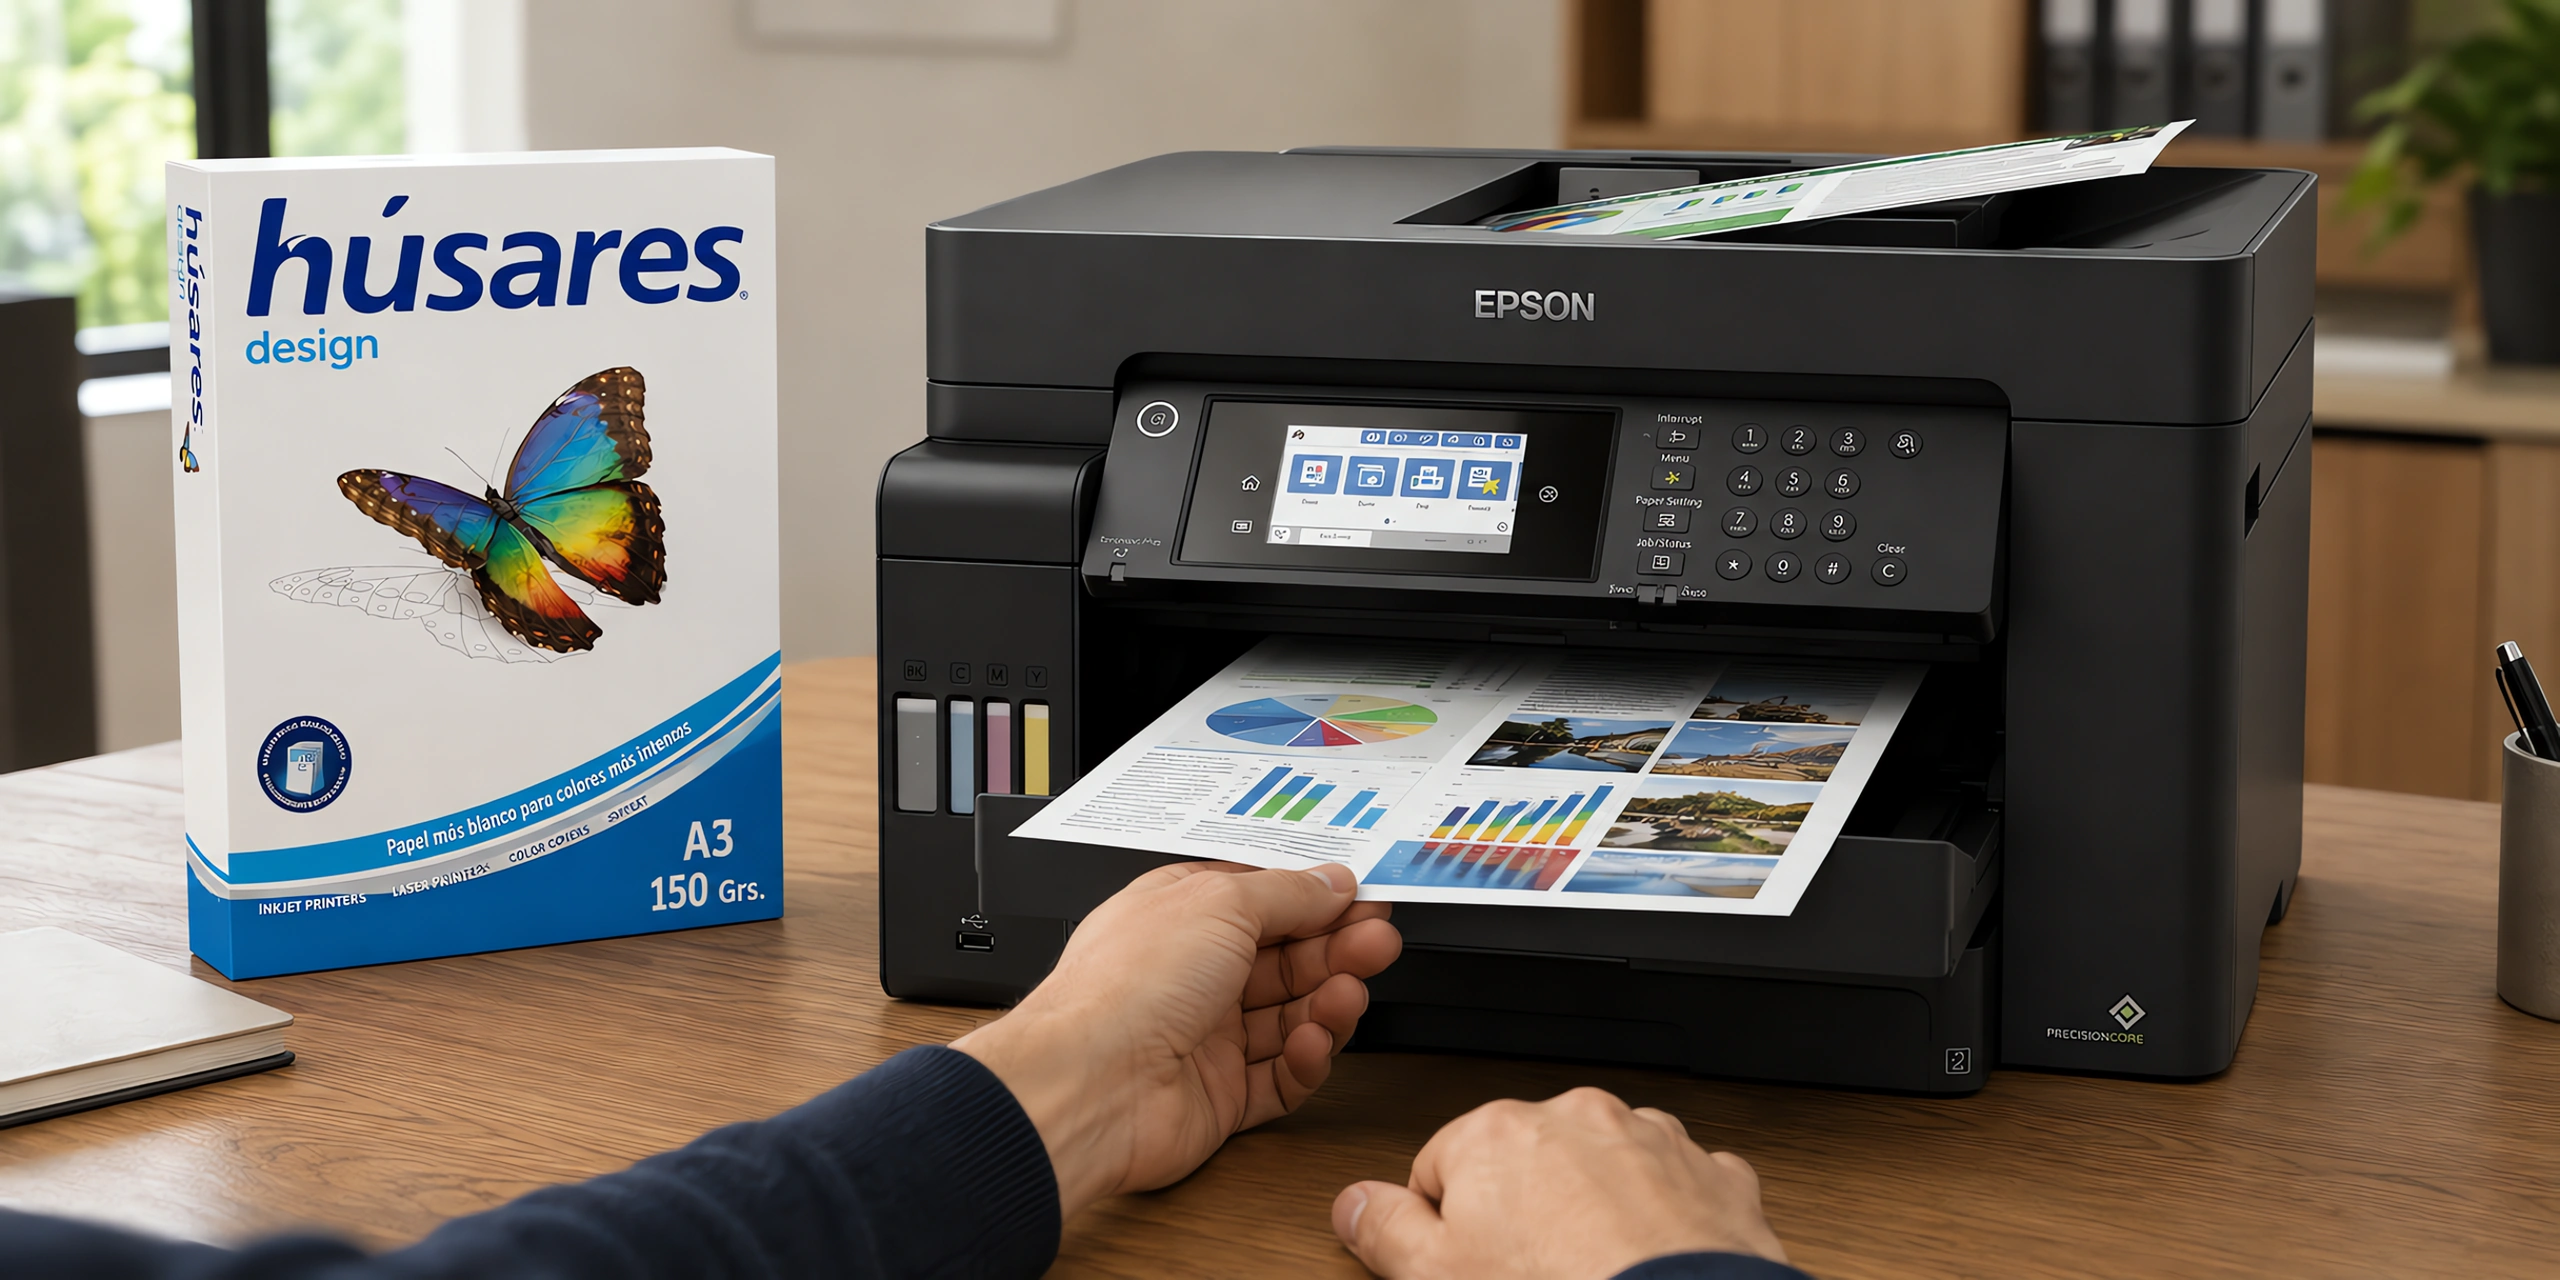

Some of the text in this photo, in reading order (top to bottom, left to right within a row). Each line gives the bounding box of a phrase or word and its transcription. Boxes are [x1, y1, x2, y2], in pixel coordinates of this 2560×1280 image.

[1474, 288, 1596, 323] EPSON
[246, 328, 379, 370] design
[1747, 428, 1753, 442] 1
[1794, 429, 1804, 443] 2
[1844, 431, 1854, 446] 3
[1660, 453, 1690, 464] Menu
[1739, 470, 1749, 482] 4
[1837, 473, 1849, 487] 6
[1736, 511, 1745, 525] 7
[1783, 513, 1794, 527] 8
[1832, 514, 1844, 528] 9
[1882, 563, 1896, 578] C
[906, 664, 924, 678] BK
[955, 667, 966, 680] C
[990, 668, 1003, 682] M
[1031, 670, 1042, 683] Y
[387, 830, 429, 857] Papel
[466, 807, 518, 835] blanco
[520, 794, 554, 821] para
[556, 768, 607, 803] colores
[683, 818, 734, 861] A3
[508, 843, 546, 864] COLOR
[392, 879, 430, 898] LASER
[651, 872, 765, 911] 150 Grs.
[258, 893, 367, 915] INKJET PRINTERS
[2046, 1027, 2145, 1046] PRECISIONCORE
